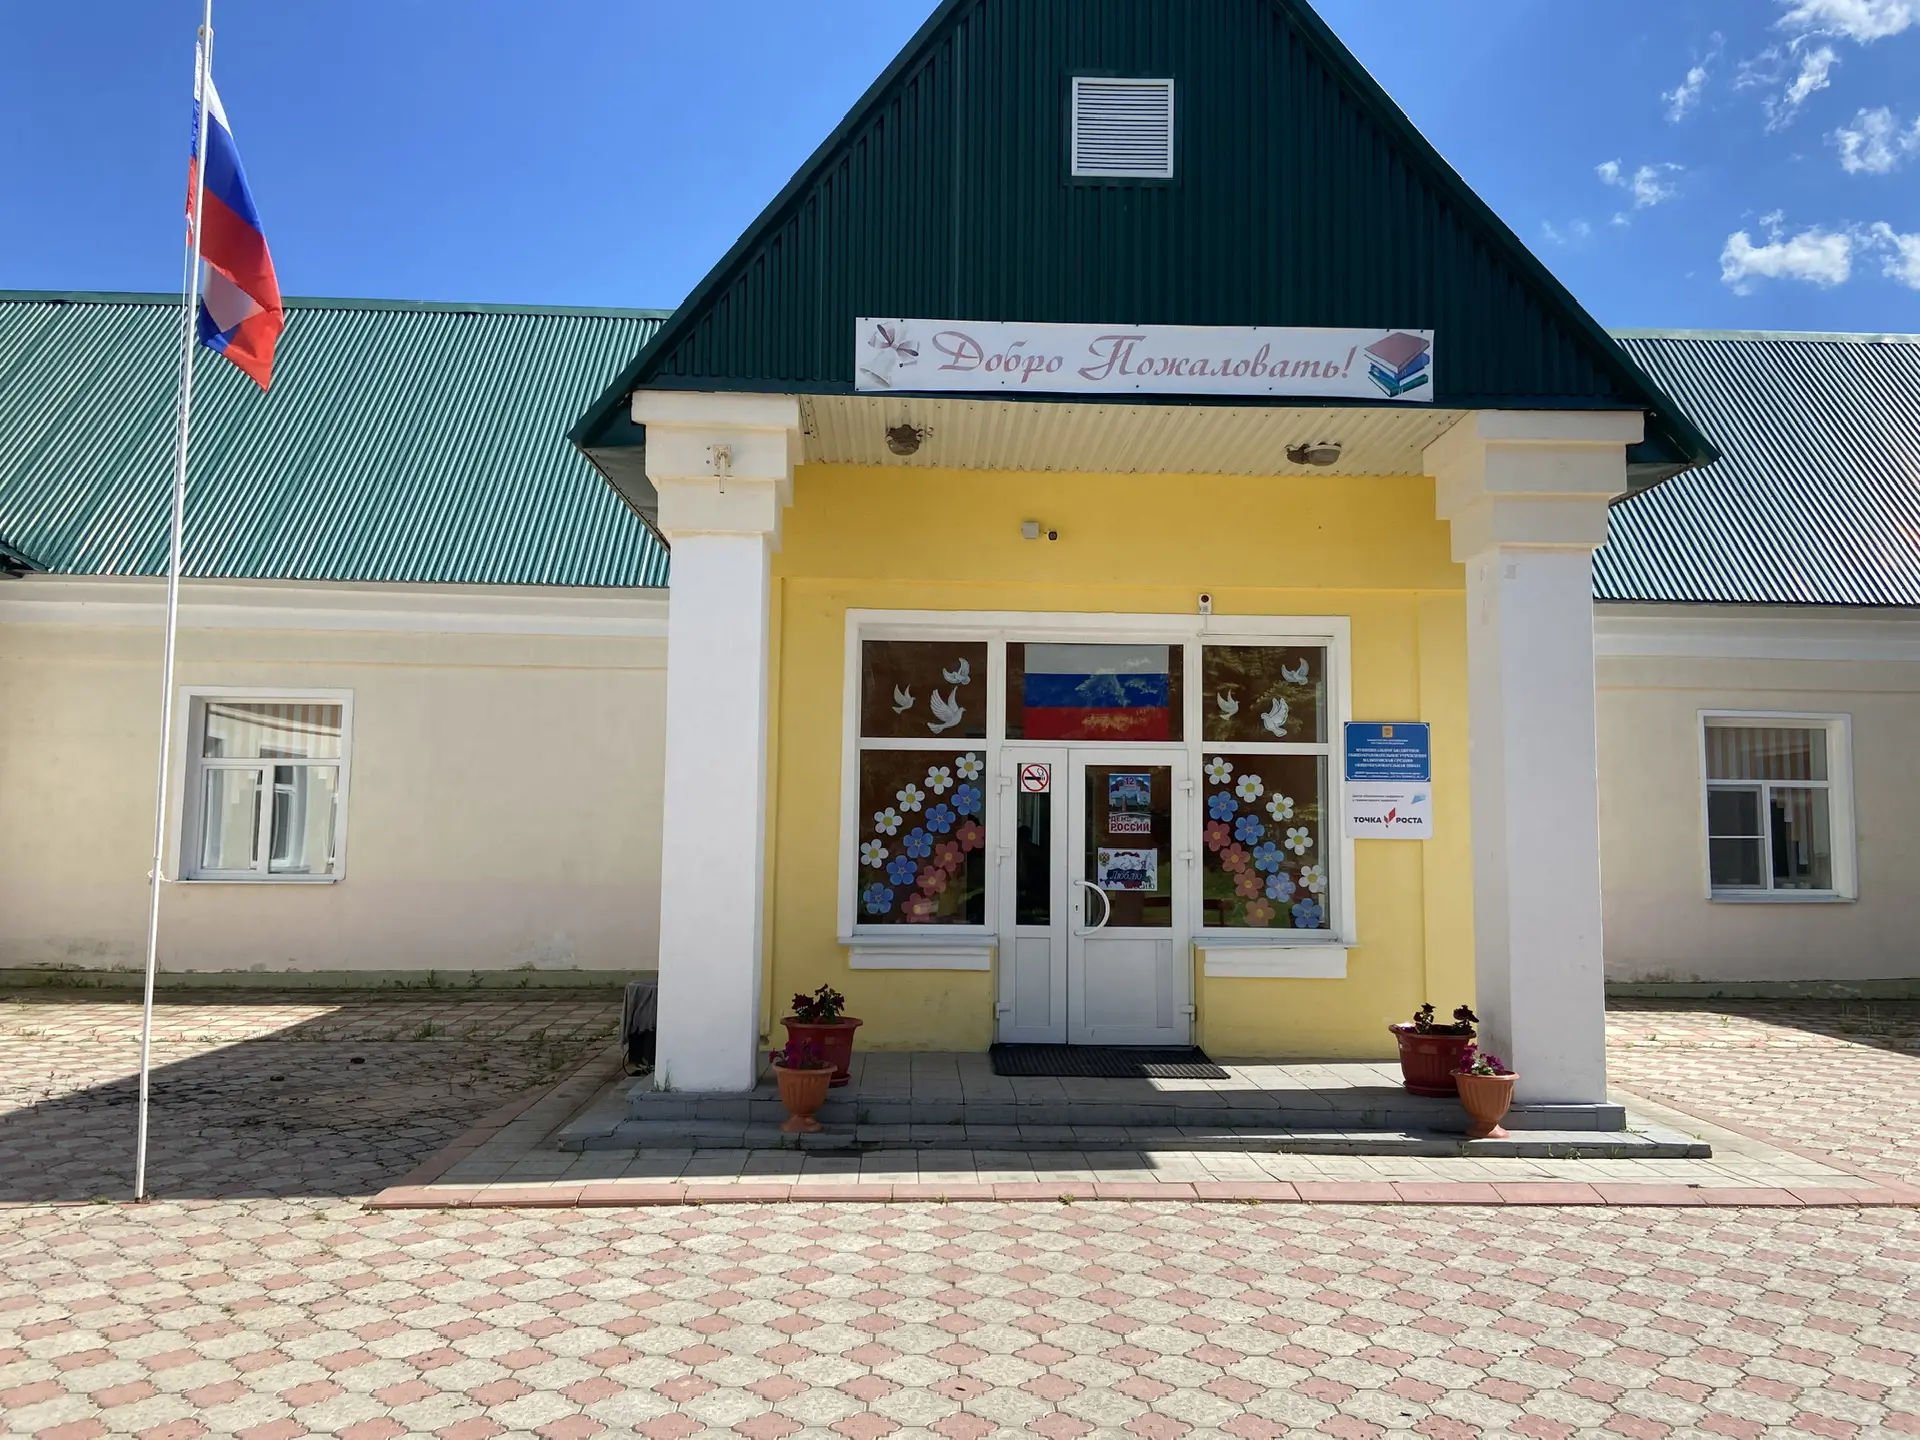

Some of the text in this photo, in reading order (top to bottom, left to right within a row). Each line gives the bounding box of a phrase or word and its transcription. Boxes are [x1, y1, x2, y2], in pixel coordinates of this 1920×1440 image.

[932, 330, 1358, 383] Добро Пожаловать!
[1124, 777, 1135, 786] 12
[1353, 816, 1382, 824] ТОЧКА
[1110, 823, 1150, 832] РОССИИ
[1109, 870, 1143, 880] Люблю
